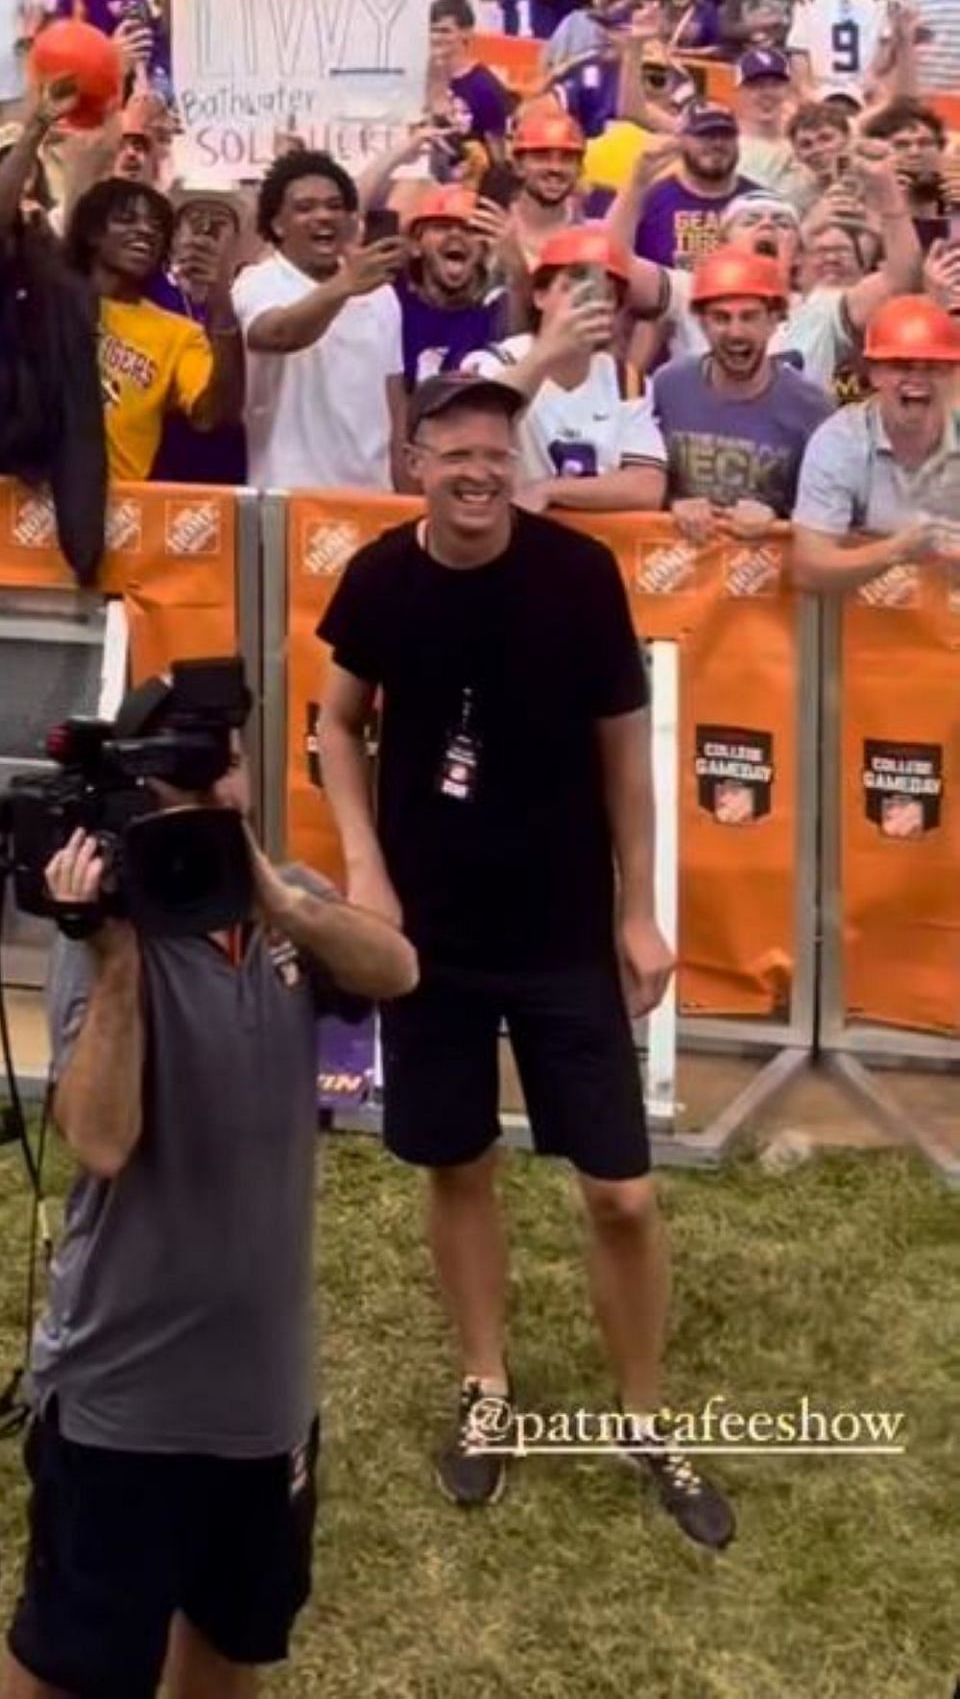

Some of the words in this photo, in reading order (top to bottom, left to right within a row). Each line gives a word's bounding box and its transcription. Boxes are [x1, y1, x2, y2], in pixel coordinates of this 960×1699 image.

[832, 21, 860, 73] 9
[196, 122, 278, 172] SOL
[704, 742, 764, 763] COLLEGE
[695, 759, 773, 783] GAMEDAY
[871, 756, 934, 775] COLLEGE
[863, 771, 941, 795] GAMEDAY
